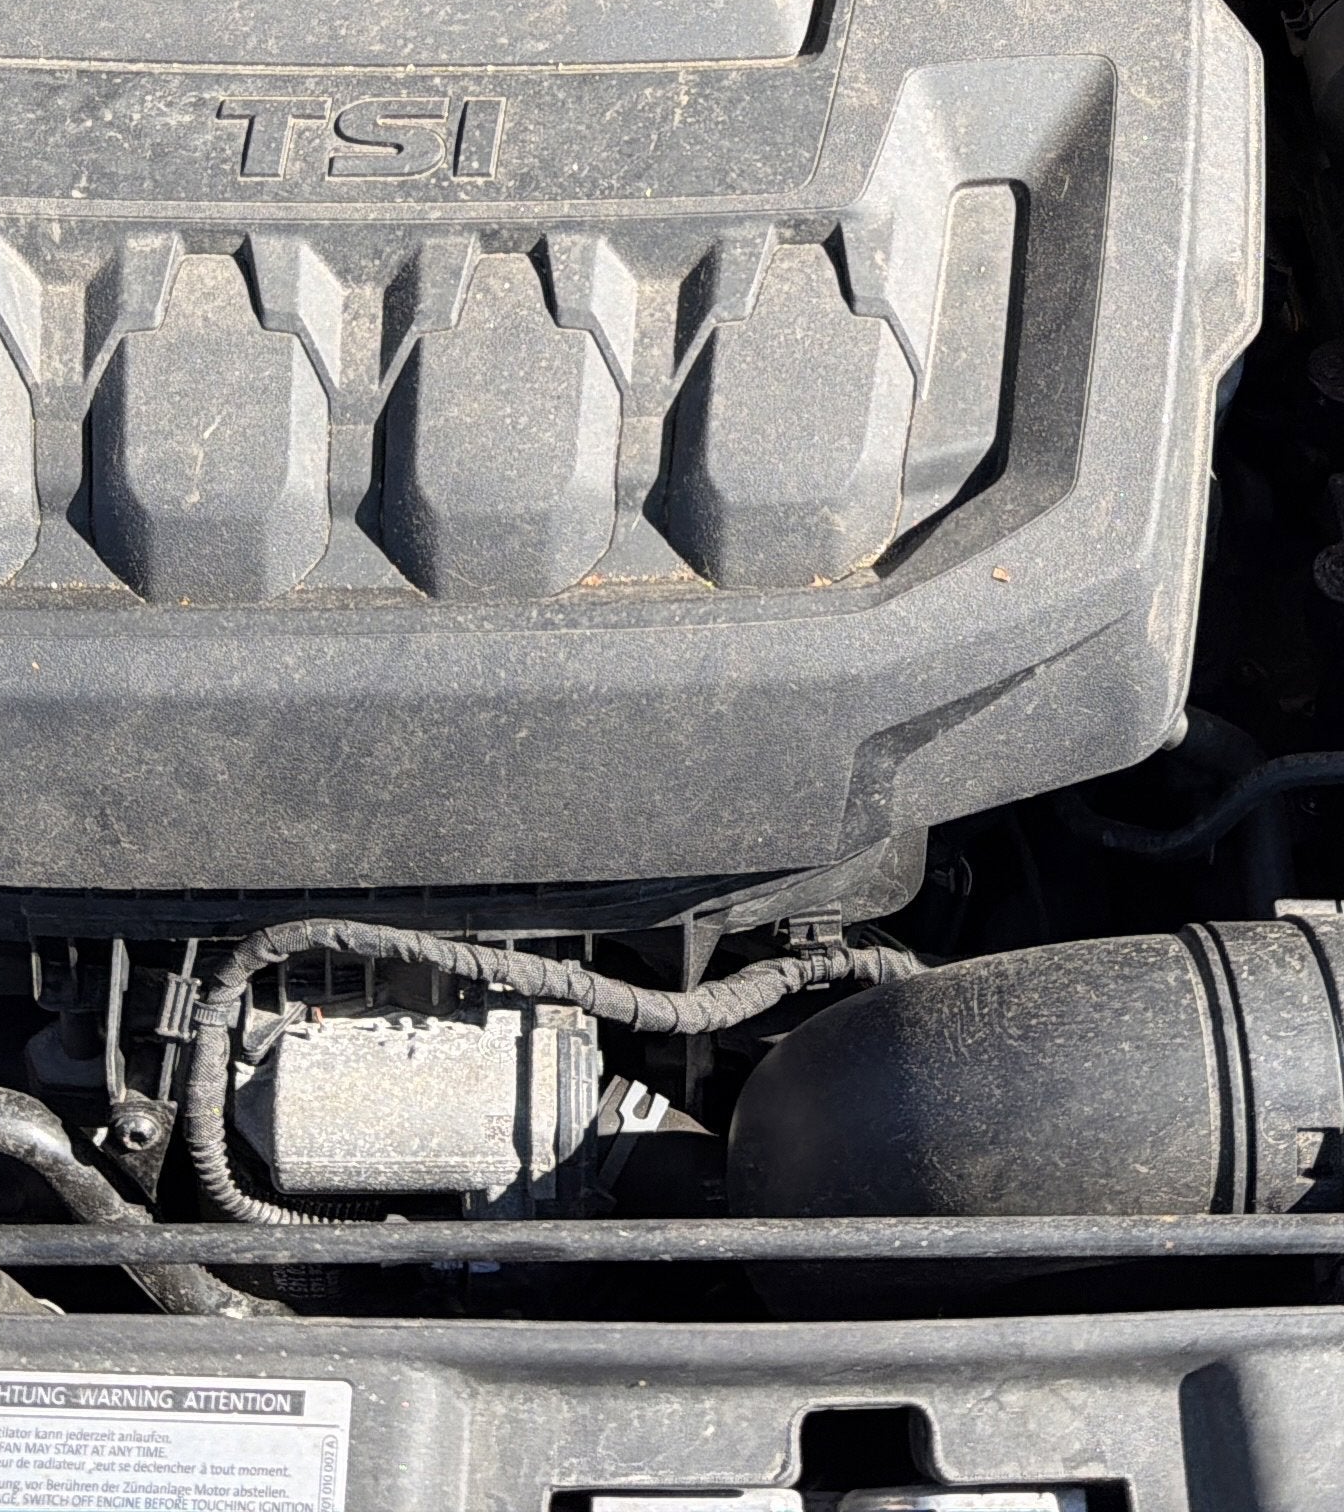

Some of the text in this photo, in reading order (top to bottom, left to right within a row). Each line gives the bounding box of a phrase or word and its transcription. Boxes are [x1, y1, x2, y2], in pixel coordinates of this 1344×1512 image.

[216, 95, 507, 183] TSI
[78, 1387, 174, 1409] WARNING
[183, 1390, 292, 1413] ATTENTION
[35, 1427, 63, 1440] kann
[64, 1428, 117, 1442] jederzeit
[118, 1430, 173, 1444] anlaufen.
[325, 1440, 336, 1449] A
[24, 1442, 50, 1454] MAY
[54, 1443, 89, 1456] START
[91, 1444, 107, 1457] AT
[107, 1445, 132, 1457] ANY
[136, 1446, 168, 1459] TIME.
[15, 1457, 31, 1469] de
[33, 1457, 85, 1471] radiateur
[118, 1461, 132, 1472] se
[199, 1461, 207, 1474] à
[210, 1463, 235, 1476] tout
[237, 1465, 292, 1478] moment.
[322, 1450, 336, 1473] 002
[25, 1480, 43, 1491] vor
[46, 1477, 99, 1492] Berühren
[101, 1479, 121, 1492] der
[123, 1480, 193, 1498] Zündanlage
[194, 1483, 231, 1496] Motor
[233, 1485, 289, 1499] abstellen.
[321, 1474, 334, 1494] 010
[22, 1493, 68, 1507] SWITCH
[71, 1494, 95, 1507] OFF
[96, 1495, 142, 1509] ENGINE
[144, 1497, 190, 1510] BEFORE
[191, 1498, 257, 1512] TOUCHING
[258, 1500, 315, 1512] IGNITION
